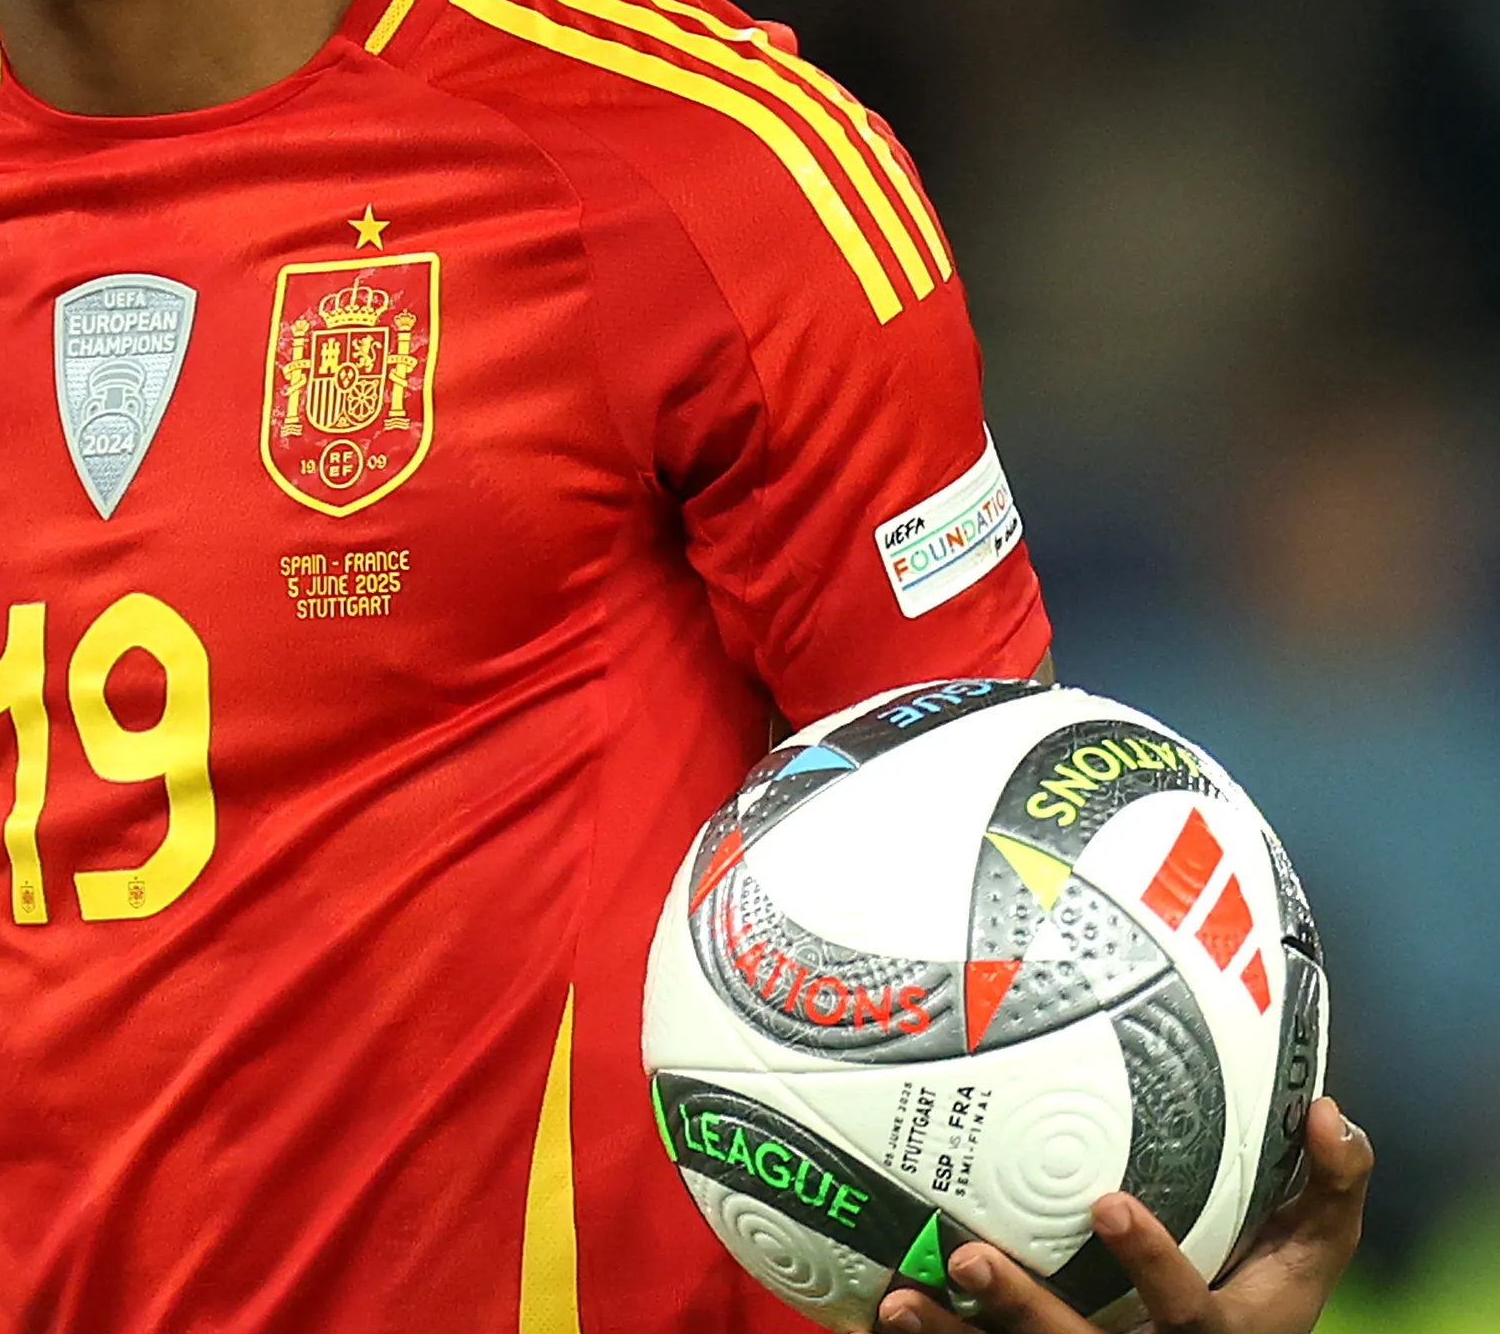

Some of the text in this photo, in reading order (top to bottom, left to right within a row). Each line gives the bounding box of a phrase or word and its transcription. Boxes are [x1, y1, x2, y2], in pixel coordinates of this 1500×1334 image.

[104, 290, 147, 308] UEFA
[68, 310, 178, 336] EUROPEAN
[67, 334, 176, 357] CHAMPIONS
[82, 436, 135, 455] 2024
[884, 517, 926, 550] UEFA
[280, 554, 327, 576] SPAIN
[344, 550, 411, 574] FRANCE
[288, 572, 401, 598] 5 JUNE 2025
[296, 595, 391, 619] STUTTGART
[901, 1087, 937, 1175] STUTTGART
[932, 1154, 954, 1193] ESP
[948, 1086, 976, 1130] FRA
[954, 1089, 993, 1198] SEMI-FINAL
[679, 1104, 871, 1229] LEAGUE
